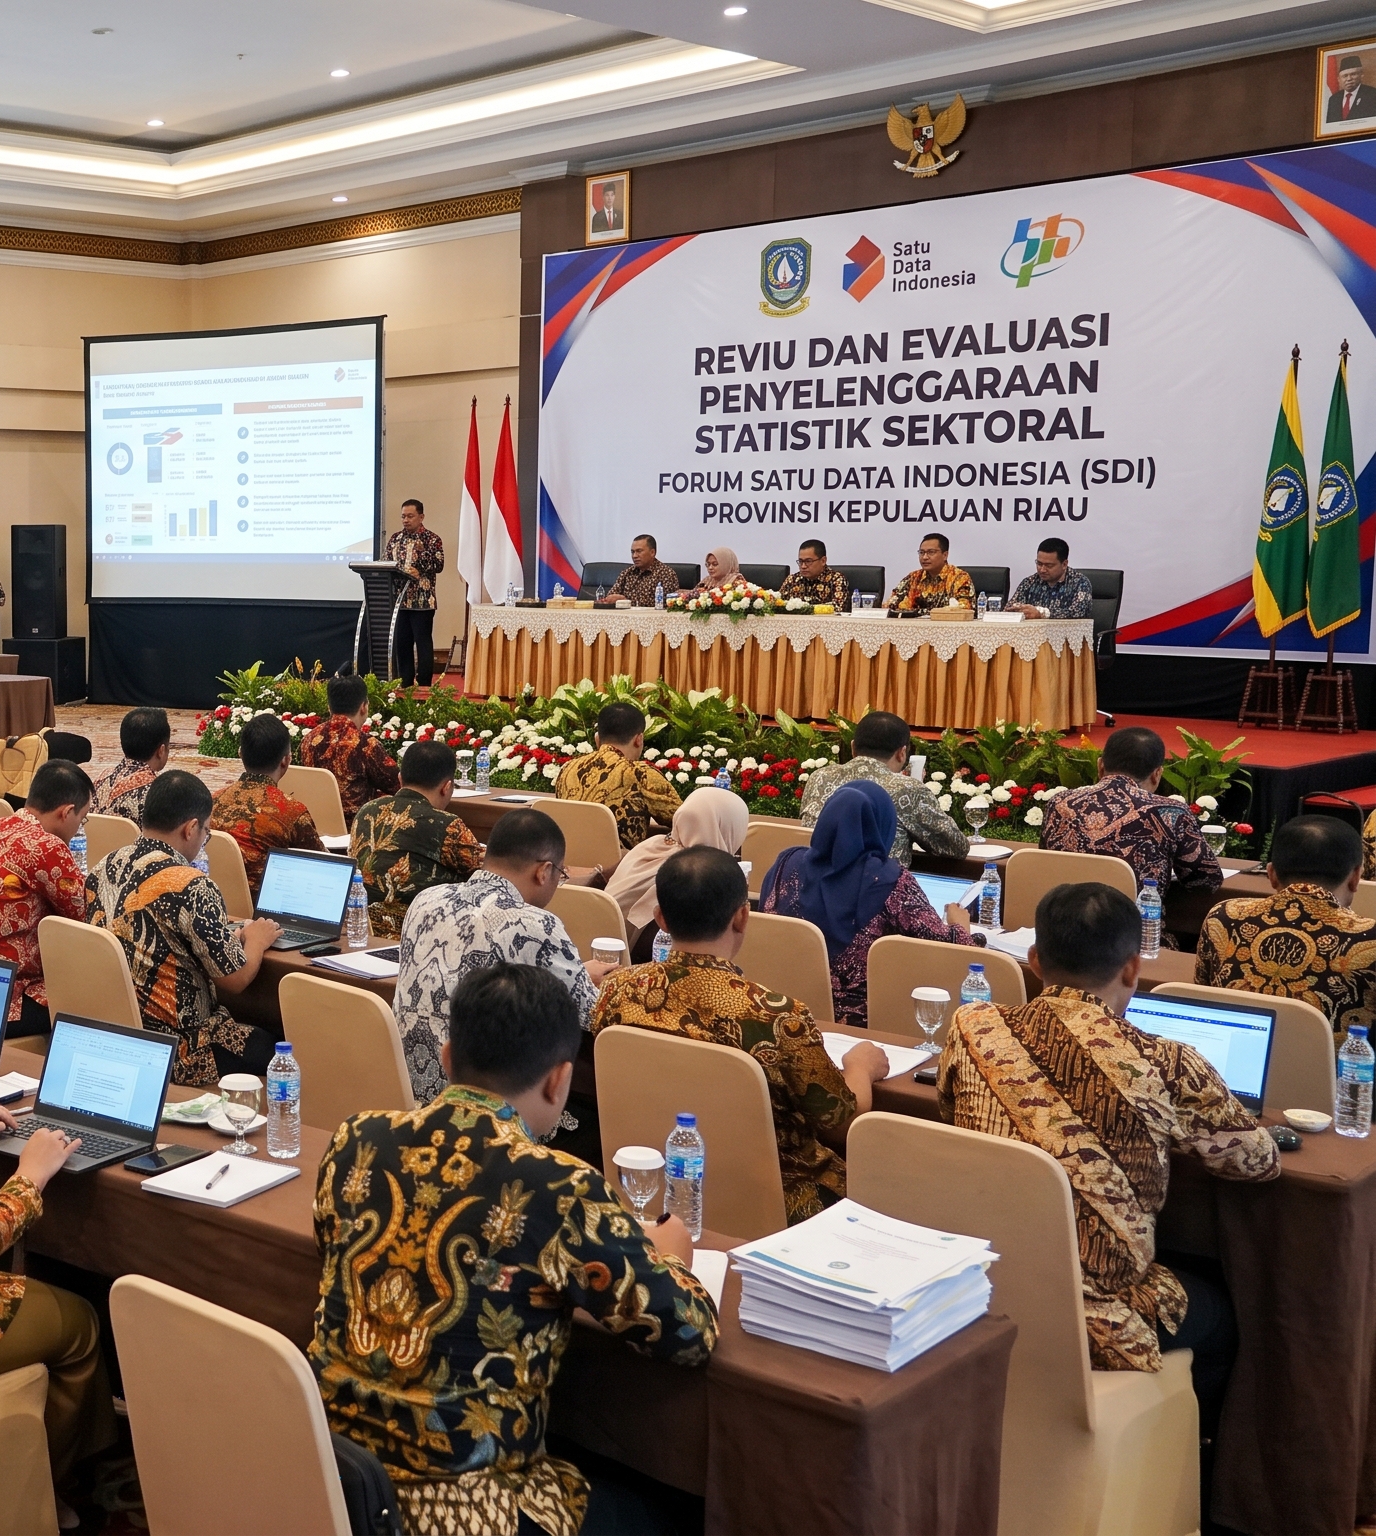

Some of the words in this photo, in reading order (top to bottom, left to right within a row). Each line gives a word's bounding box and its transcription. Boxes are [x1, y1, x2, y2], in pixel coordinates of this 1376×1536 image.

[892, 240, 931, 257] Satu
[892, 270, 976, 293] Indonesia
[893, 257, 931, 275] Data
[694, 340, 796, 376] REVIU
[808, 331, 889, 369] DAN
[901, 312, 1110, 362] EVALUASI
[699, 359, 1099, 415] PENYELENGGARAAN
[694, 417, 872, 455] STATISTIK
[882, 405, 1105, 448] SEKTORAL
[658, 470, 743, 494] FORUM
[750, 468, 815, 492] SATU
[823, 465, 896, 490] DATA
[903, 460, 1071, 489] INDONESIA
[1080, 456, 1156, 491] (SDI)
[702, 500, 820, 524] PROVINSI
[828, 497, 1003, 523] KEPULAUAN
[1013, 496, 1089, 522] RIAU
